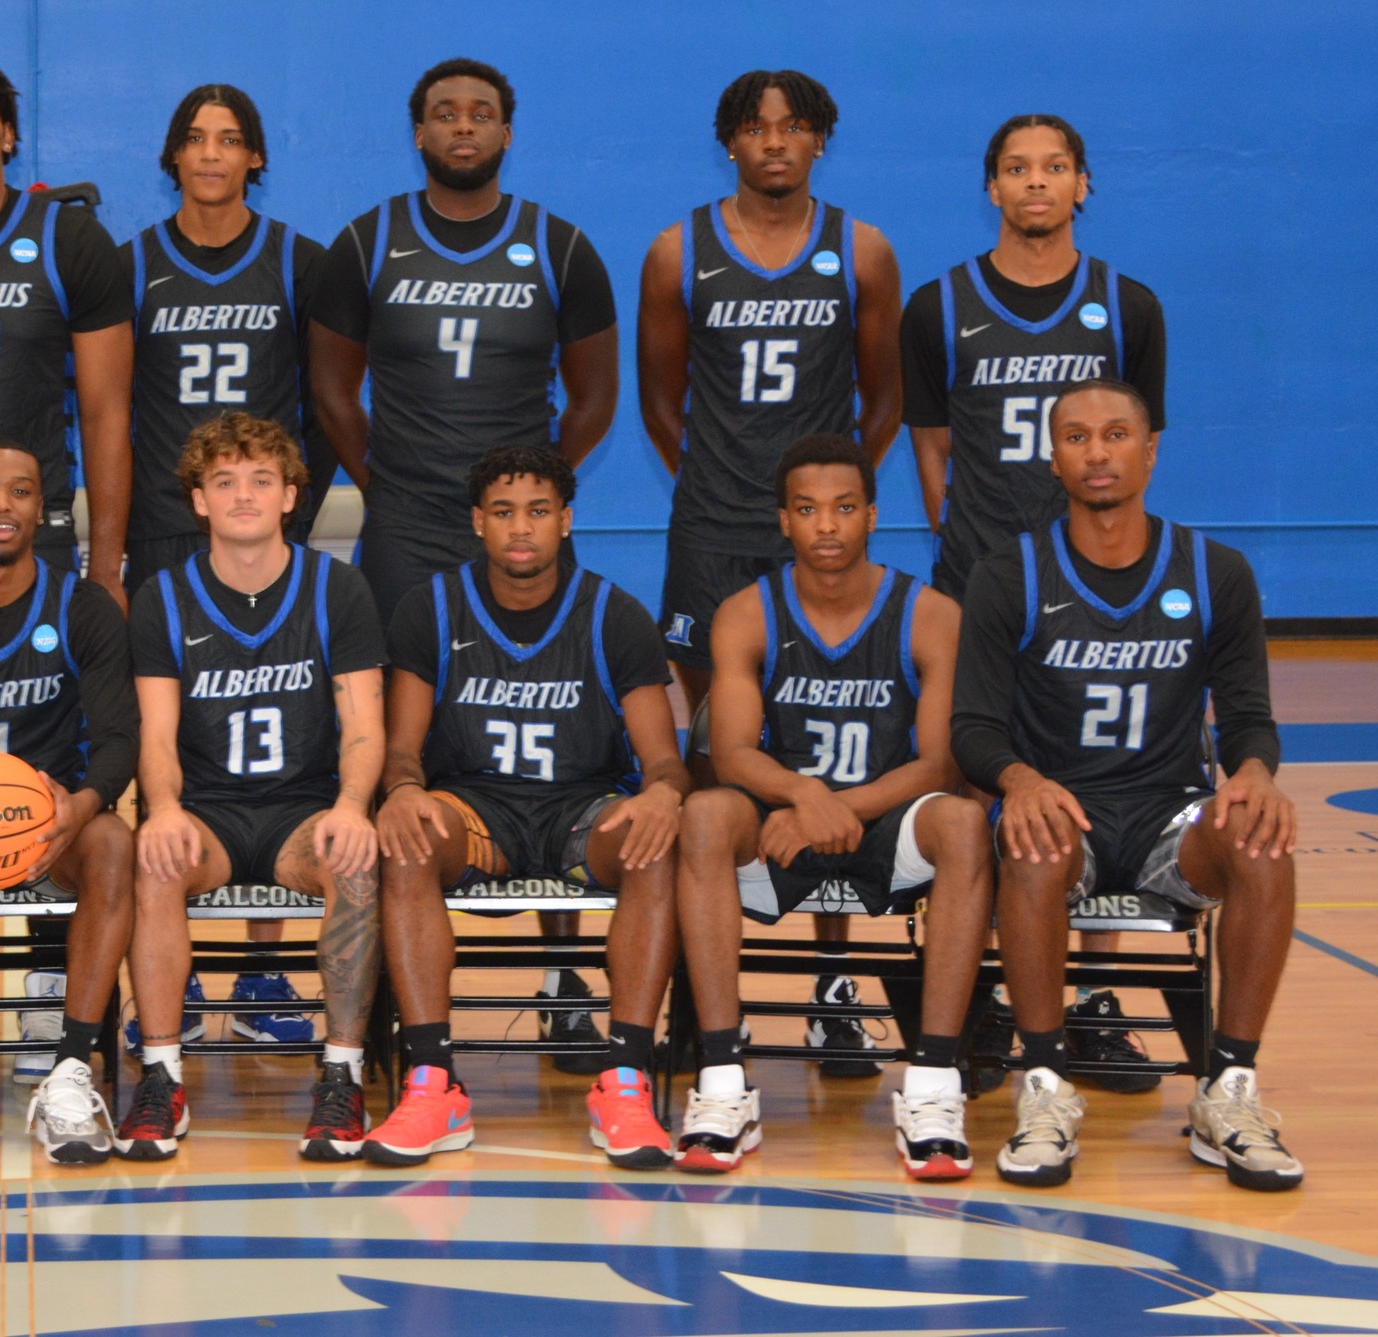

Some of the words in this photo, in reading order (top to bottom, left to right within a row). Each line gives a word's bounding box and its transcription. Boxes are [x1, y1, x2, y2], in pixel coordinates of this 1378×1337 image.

[385, 277, 539, 310] ALBERTUS
[705, 298, 841, 329] ALBERTUS
[150, 303, 282, 335] ALBERTUS
[437, 316, 480, 379] 4
[178, 341, 250, 405] 22
[739, 338, 800, 404] 15
[970, 353, 1108, 387] ALBERTUS
[1042, 638, 1194, 671] ALBERTUS
[188, 659, 315, 700] ALBERTUS
[455, 676, 585, 711] ALBERTUS
[774, 676, 896, 709] ALBERTUS
[1080, 683, 1149, 750] 21
[226, 706, 286, 776] 13
[485, 719, 556, 782] 35
[797, 719, 870, 784] 30
